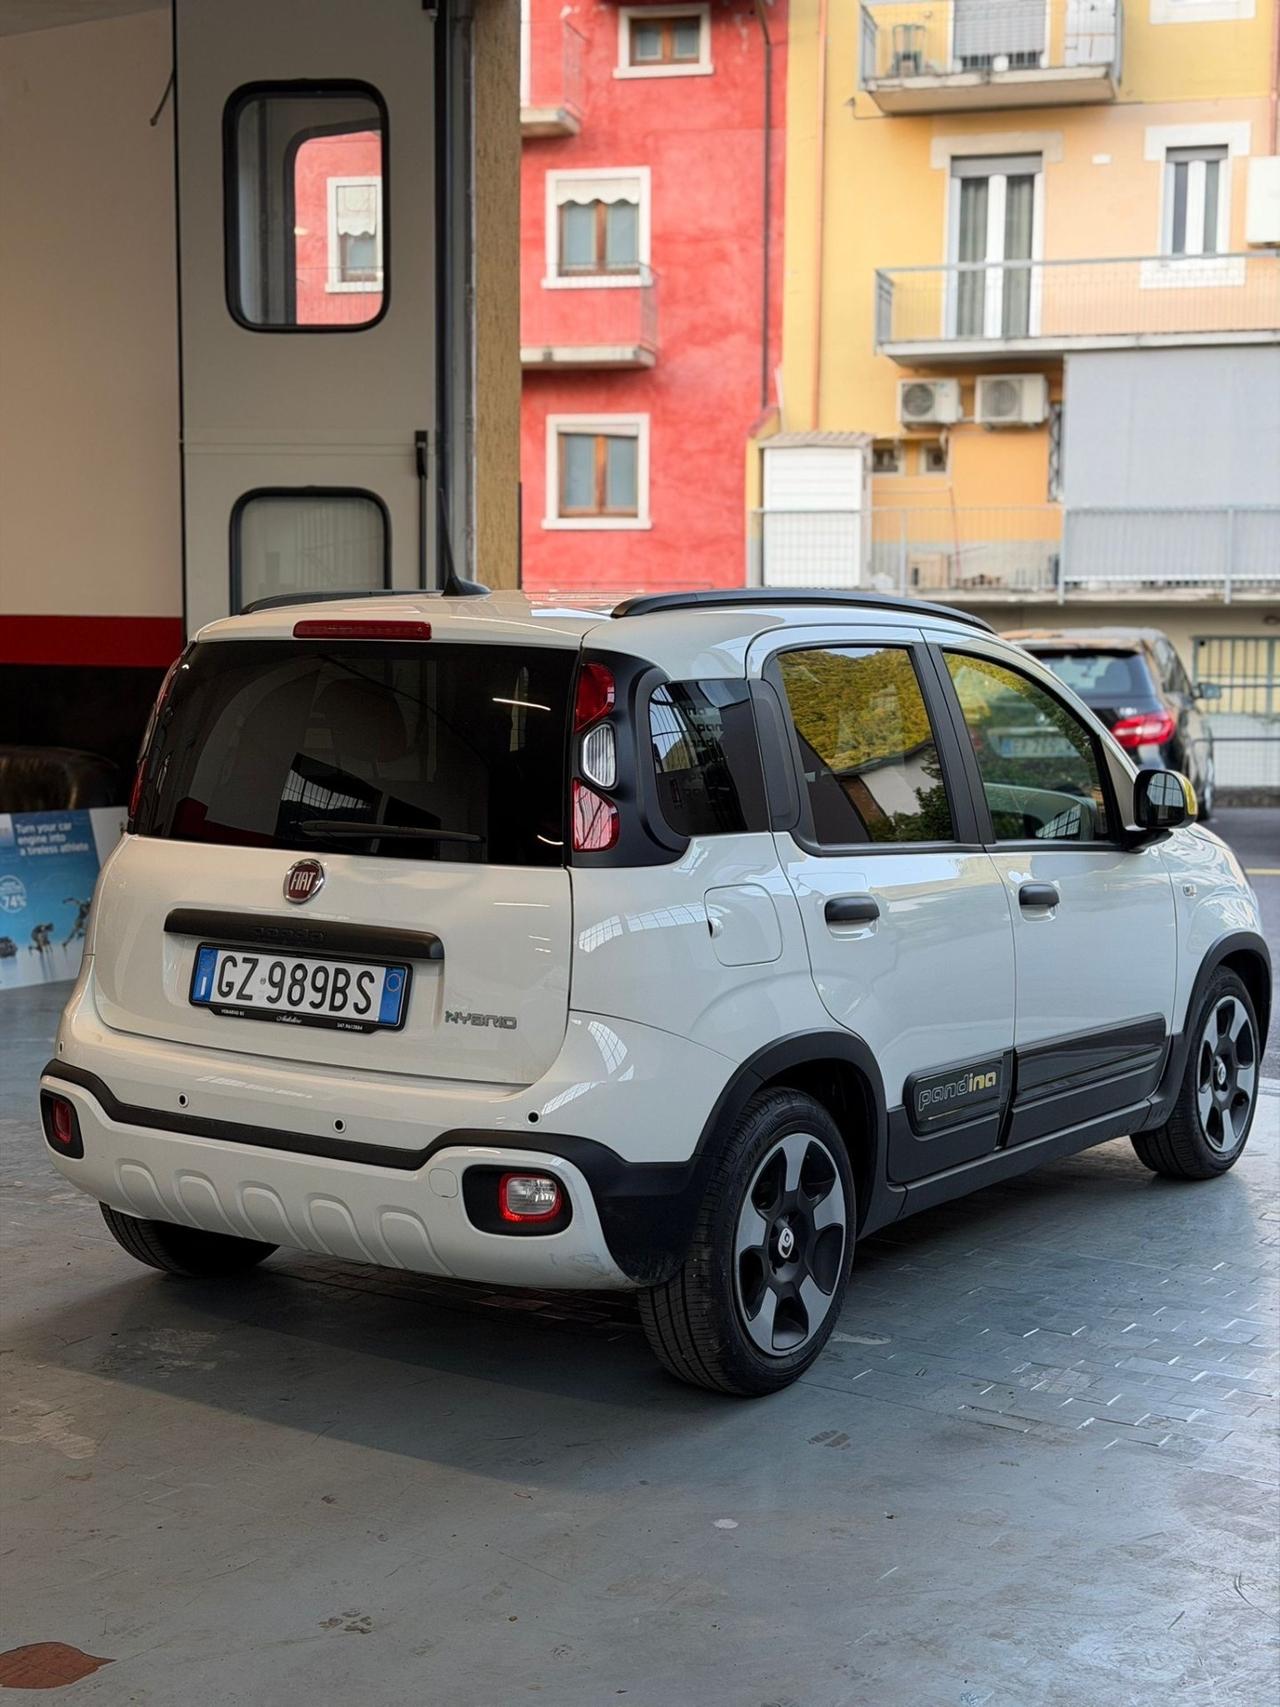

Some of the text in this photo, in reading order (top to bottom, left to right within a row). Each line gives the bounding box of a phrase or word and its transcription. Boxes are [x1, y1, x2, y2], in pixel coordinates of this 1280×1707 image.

[15, 823, 36, 834] Turn
[37, 823, 57, 834] your
[58, 822, 72, 832] car
[17, 833, 66, 846] engine into
[290, 871, 316, 891] FIAT
[918, 1071, 997, 1112] pandina
